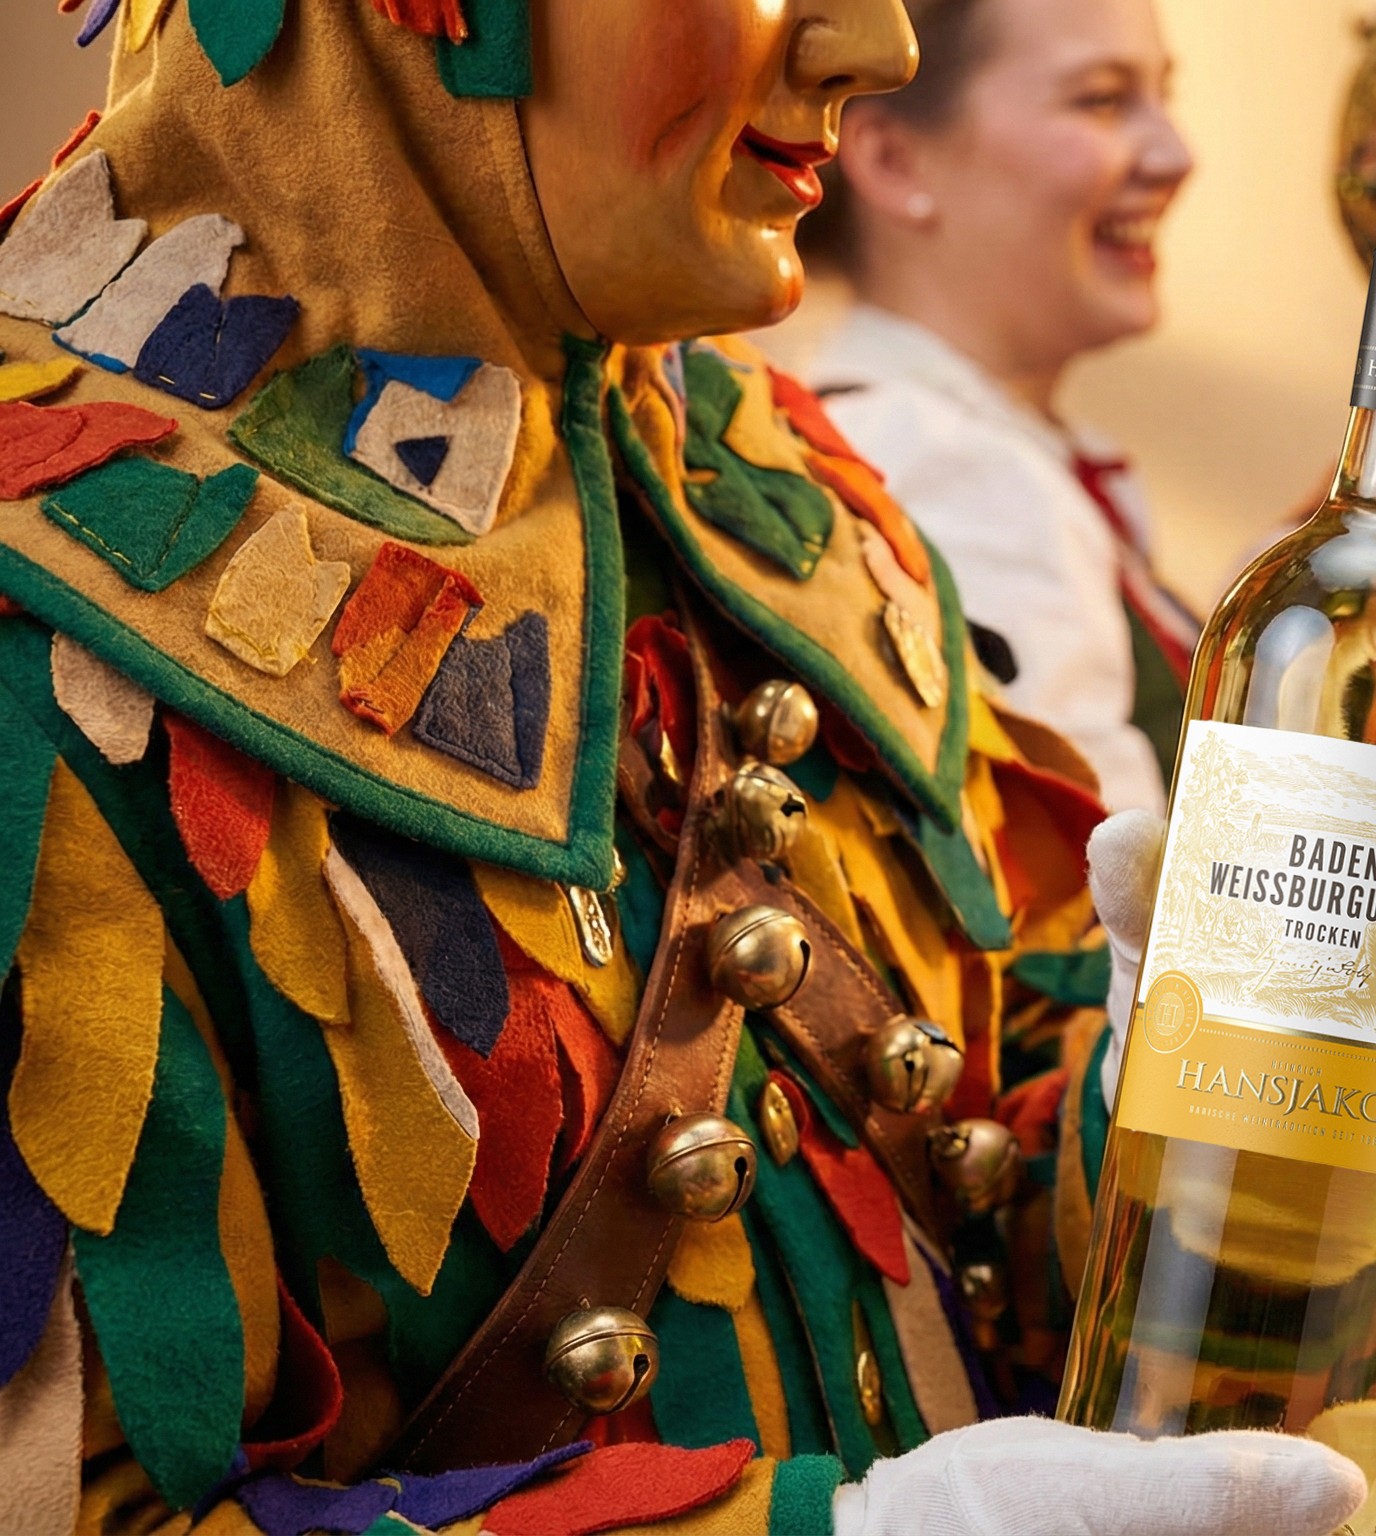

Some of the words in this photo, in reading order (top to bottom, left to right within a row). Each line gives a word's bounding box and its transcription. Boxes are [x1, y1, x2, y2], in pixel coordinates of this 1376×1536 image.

[1284, 919, 1362, 949] TROCKEN
[1271, 1060, 1323, 1076] HEINRICH
[1242, 1114, 1326, 1137] WEINTRADITION
[1332, 1130, 1355, 1143] SEIT
